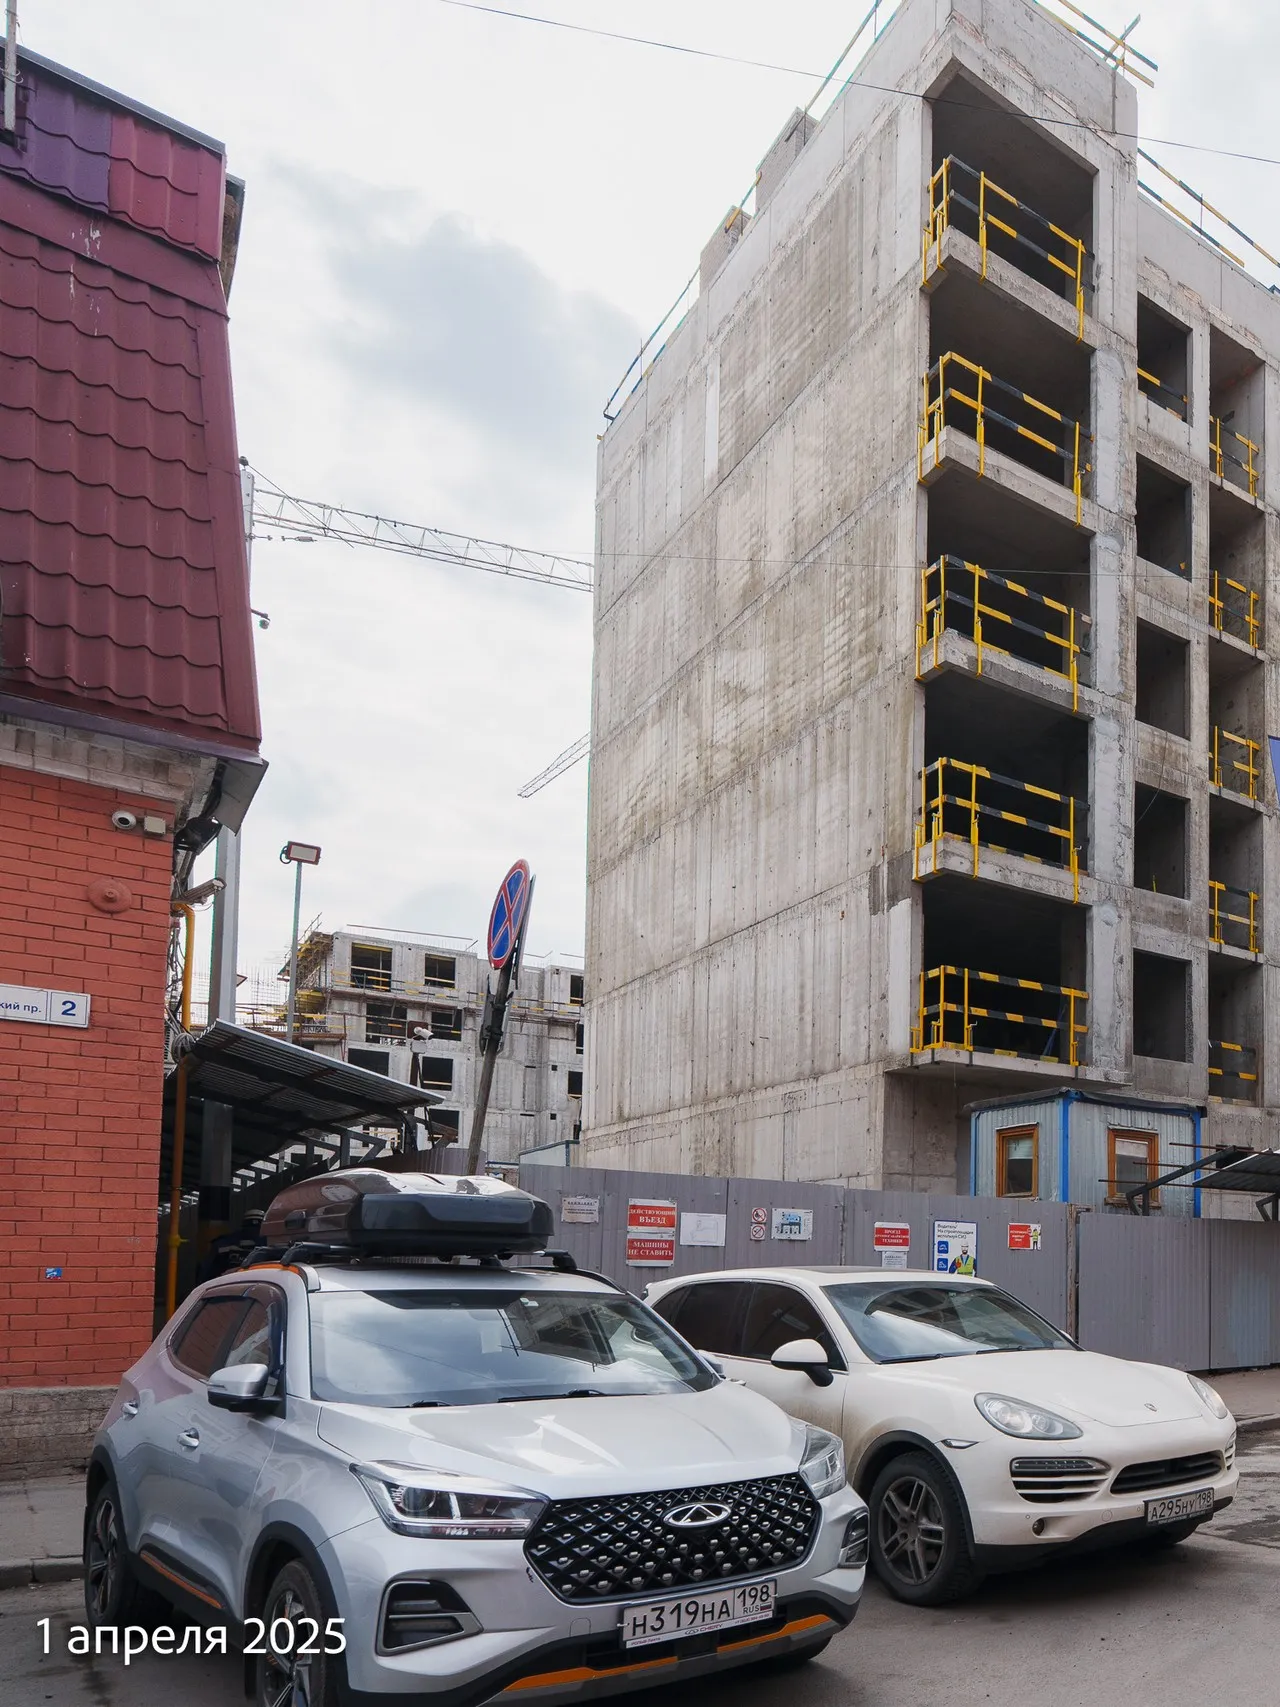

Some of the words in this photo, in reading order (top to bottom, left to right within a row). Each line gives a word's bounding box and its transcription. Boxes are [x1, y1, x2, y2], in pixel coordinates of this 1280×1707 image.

[23, 1004, 42, 1014] пр.
[61, 1000, 76, 1017] 2
[639, 1216, 666, 1224] ВЪЕЗД
[1151, 1499, 1196, 1520] А295НУ
[1196, 1491, 1212, 1505] 198
[632, 1599, 731, 1637] Н319НА
[737, 1584, 771, 1607] 198
[743, 1605, 760, 1614] RUS
[699, 1623, 723, 1632] CHERY
